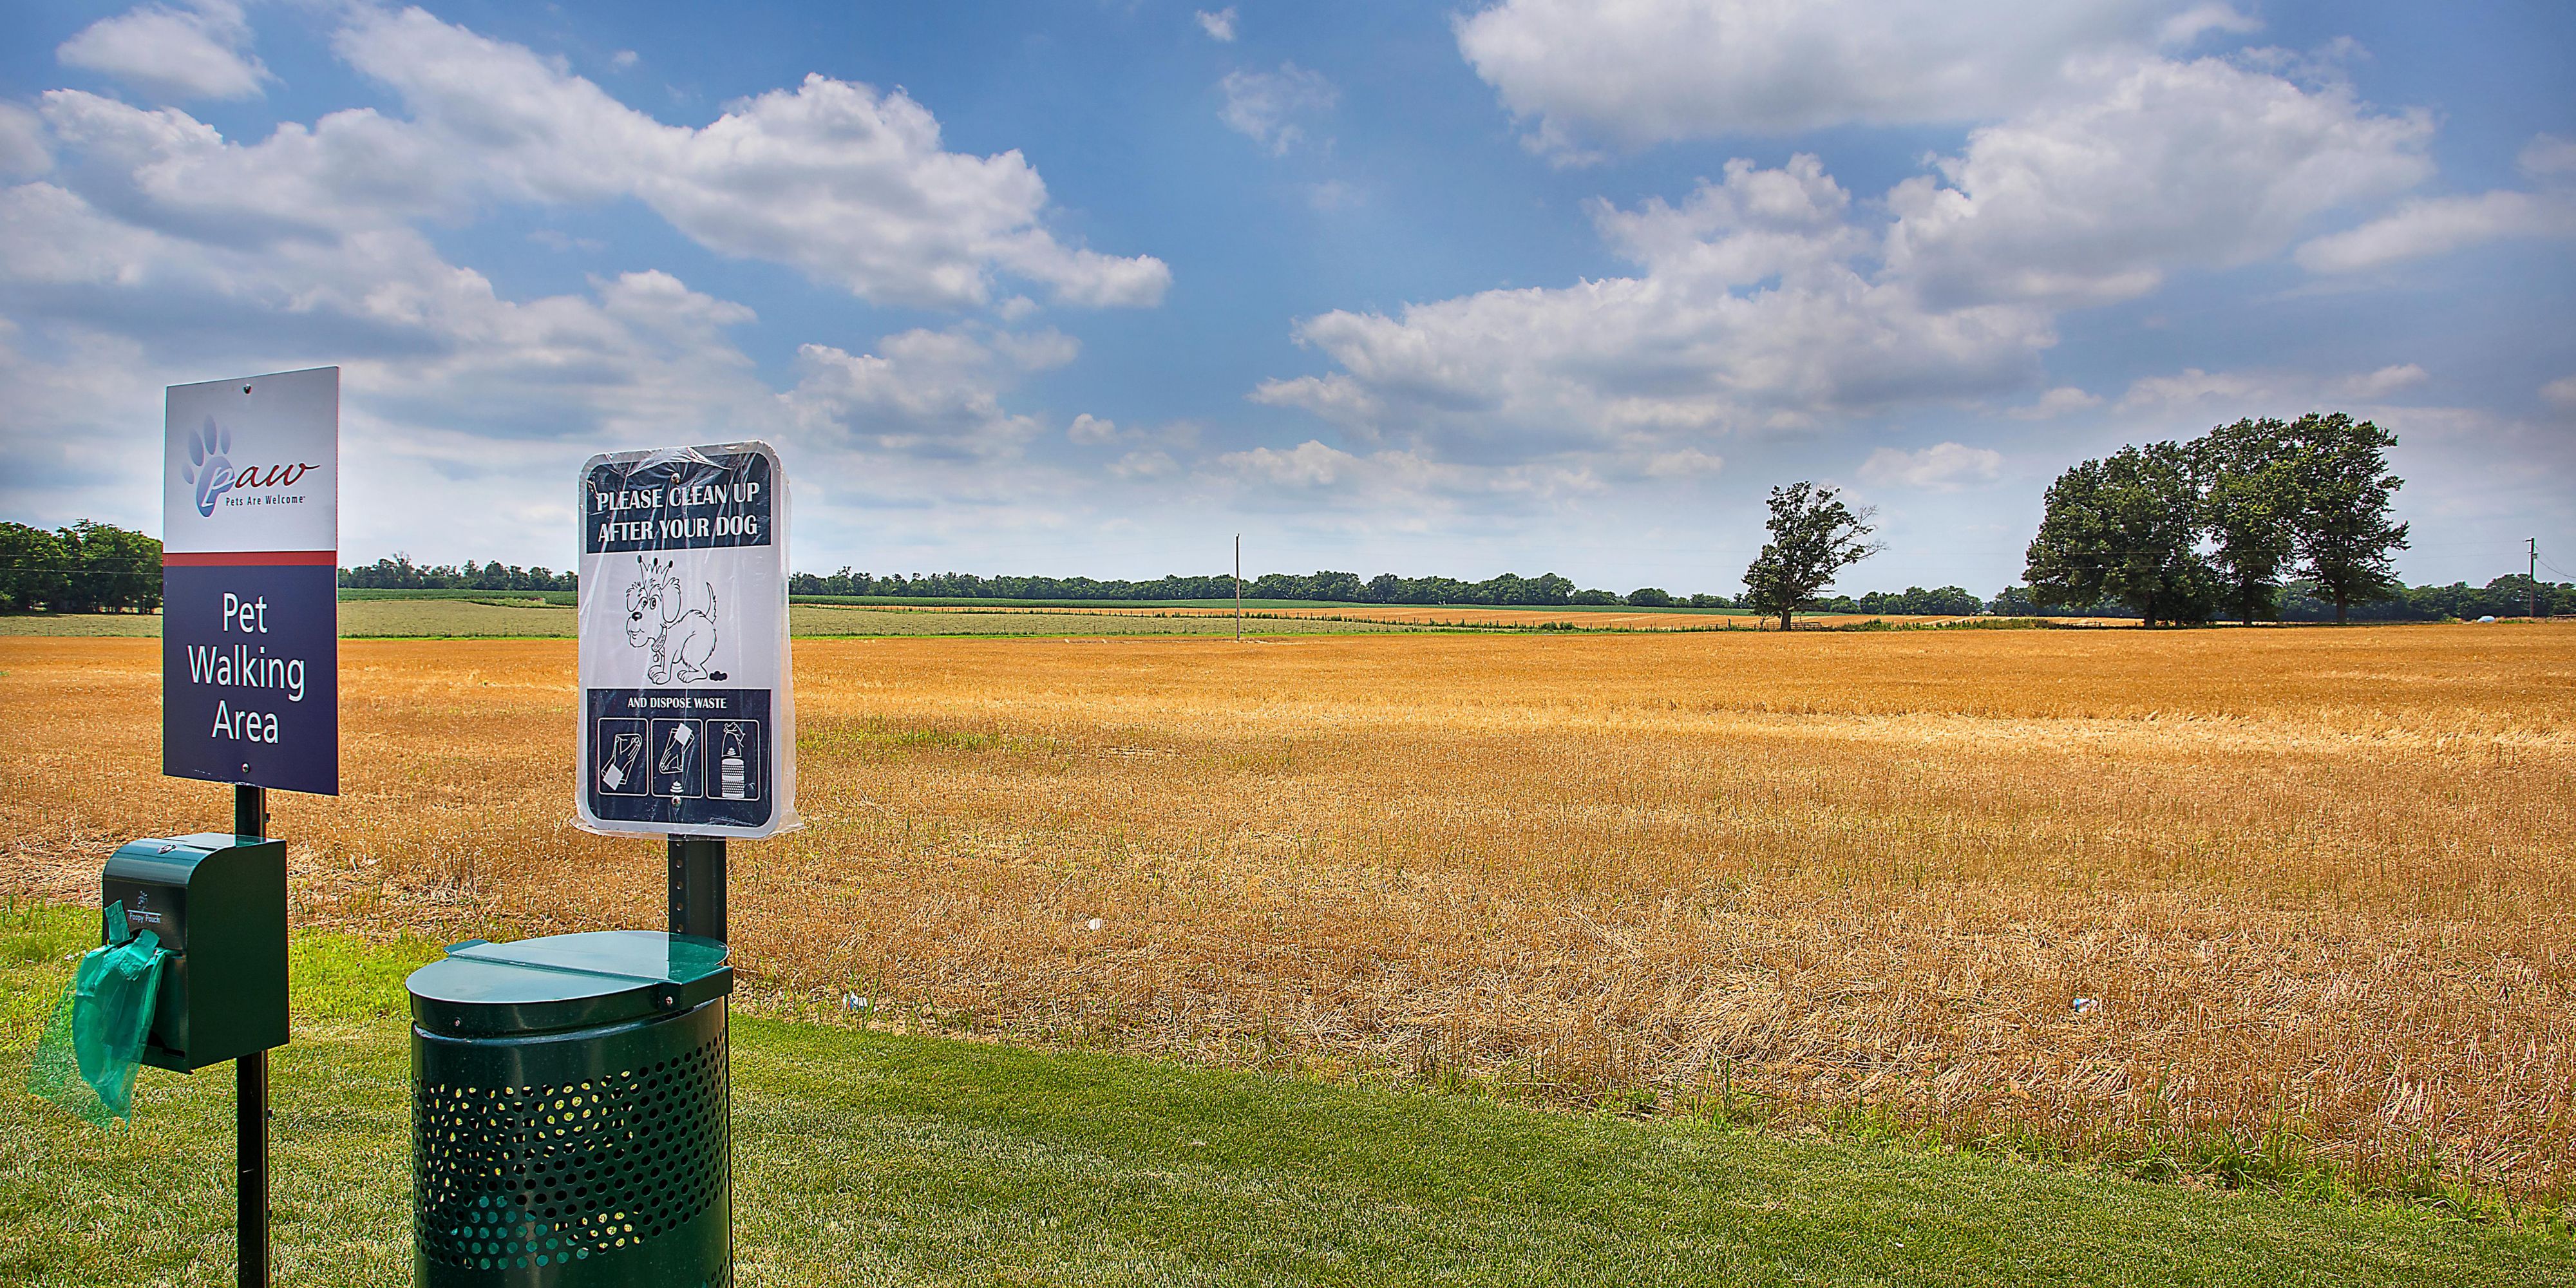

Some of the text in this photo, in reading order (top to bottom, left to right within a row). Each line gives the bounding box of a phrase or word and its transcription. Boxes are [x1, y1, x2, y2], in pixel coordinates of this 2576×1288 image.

[201, 462, 321, 507] paw
[597, 482, 760, 511] PLEASE CLEAN UP
[226, 497, 243, 506] Pets
[247, 496, 261, 506] Are
[598, 515, 758, 542] AFTER YOUR DOG
[223, 592, 268, 633] Pet
[187, 644, 305, 701] Walking
[627, 697, 727, 708] AND DISPOSE WASTE
[211, 699, 279, 744] Area
[129, 912, 160, 923] Poopy Pouch
